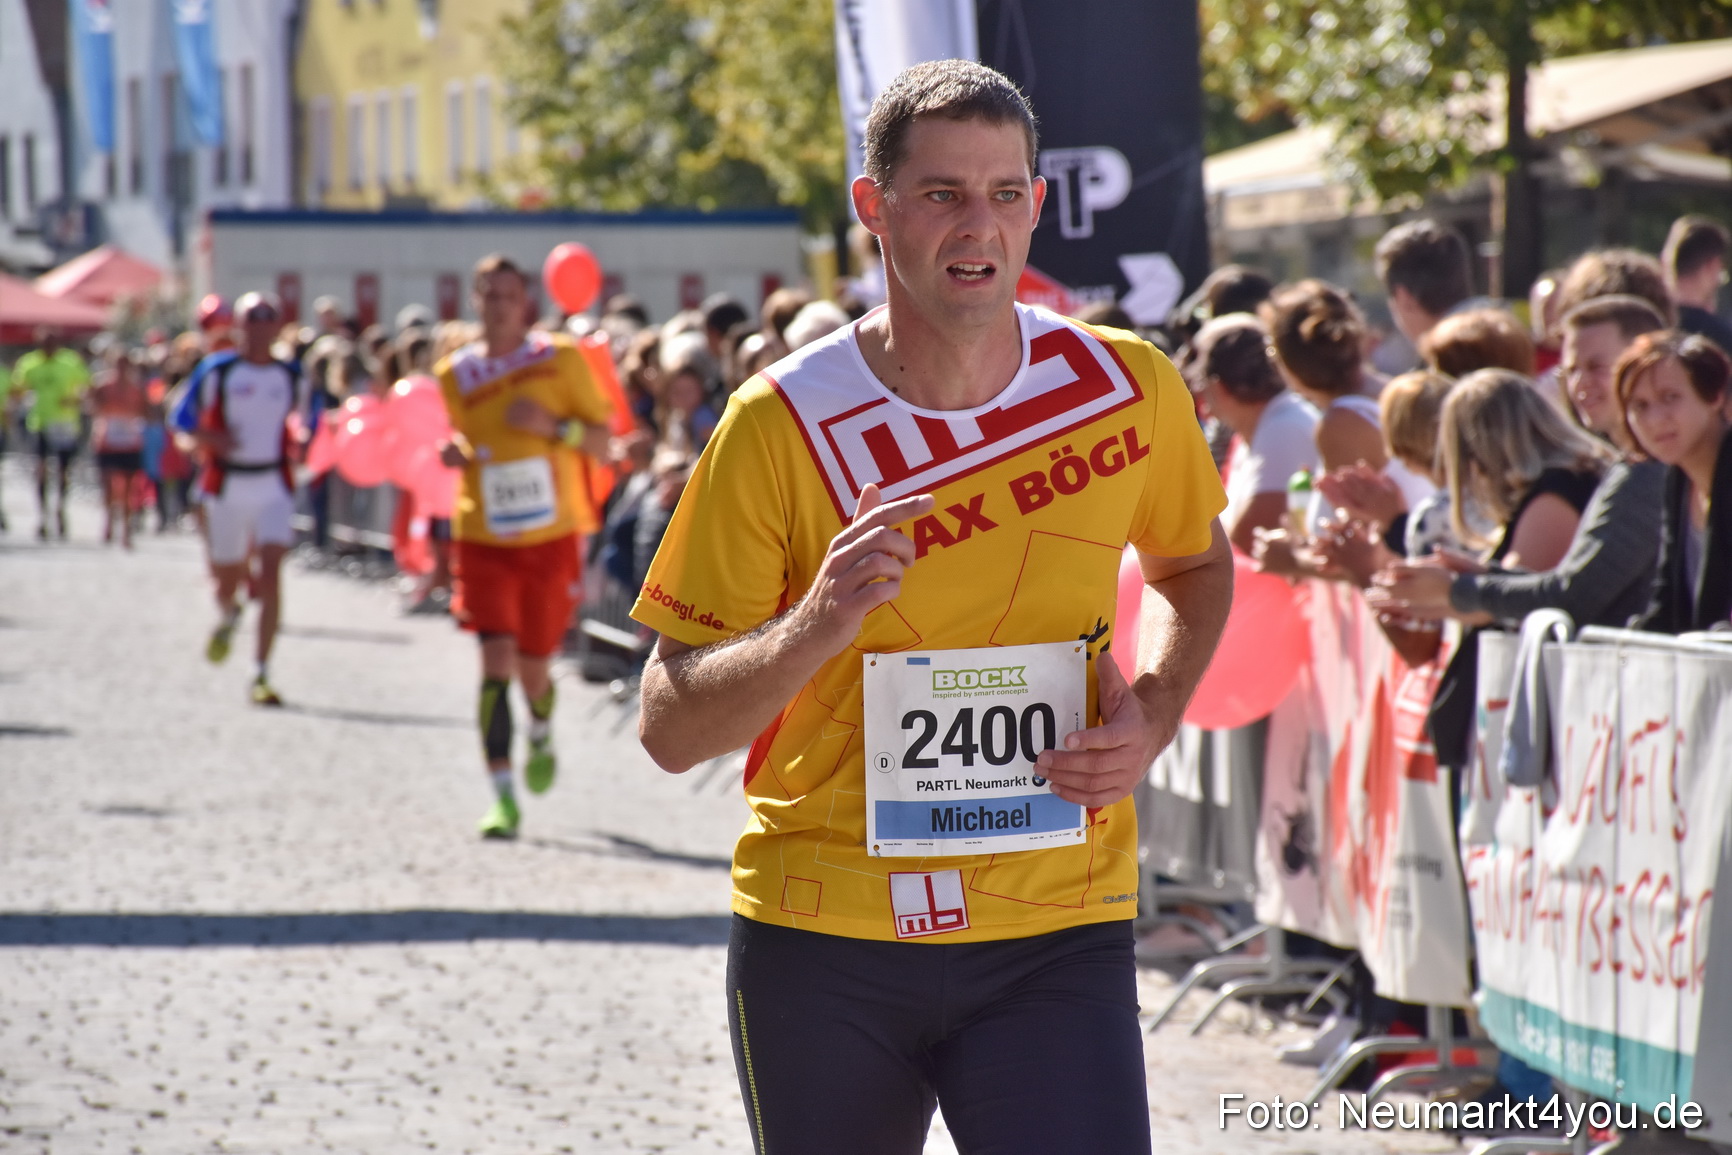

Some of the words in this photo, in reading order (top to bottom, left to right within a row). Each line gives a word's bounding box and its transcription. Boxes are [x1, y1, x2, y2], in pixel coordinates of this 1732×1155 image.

[1008, 425, 1151, 517] BÖGL
[932, 665, 1028, 691] BOCK
[932, 691, 962, 700] inspired
[963, 691, 973, 699] by
[974, 689, 995, 697] smart
[996, 687, 1029, 696] concepts
[901, 702, 1056, 769] 2400
[879, 756, 889, 769] D
[916, 778, 962, 792] PARTL
[965, 776, 1028, 790] Neumarkt
[931, 802, 1031, 833] Michael
